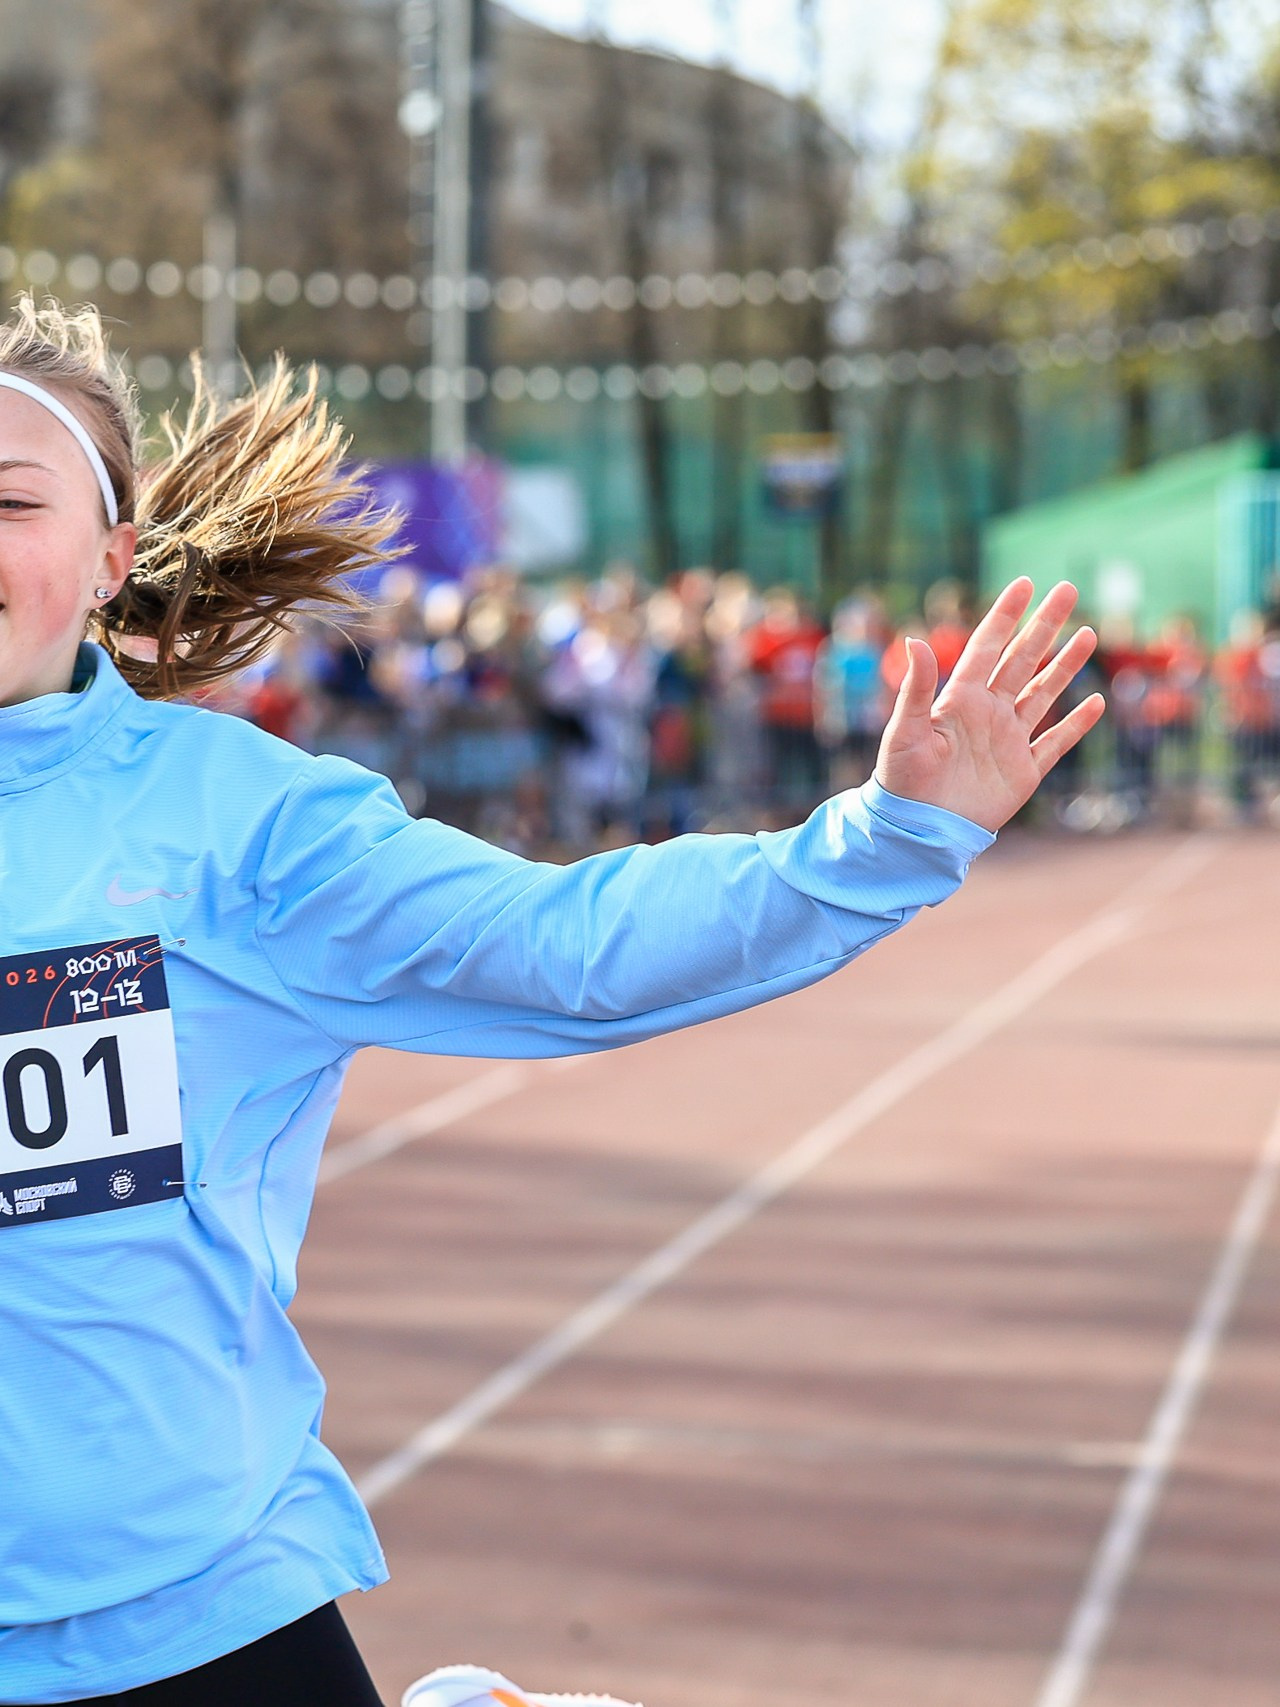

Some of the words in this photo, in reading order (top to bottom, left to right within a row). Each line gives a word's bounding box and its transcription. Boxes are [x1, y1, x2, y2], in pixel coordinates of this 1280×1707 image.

[65, 953, 112, 978] 800
[13, 1177, 78, 1202] МОСКОВСКИЙ
[15, 1197, 46, 1215] СПОРТ
